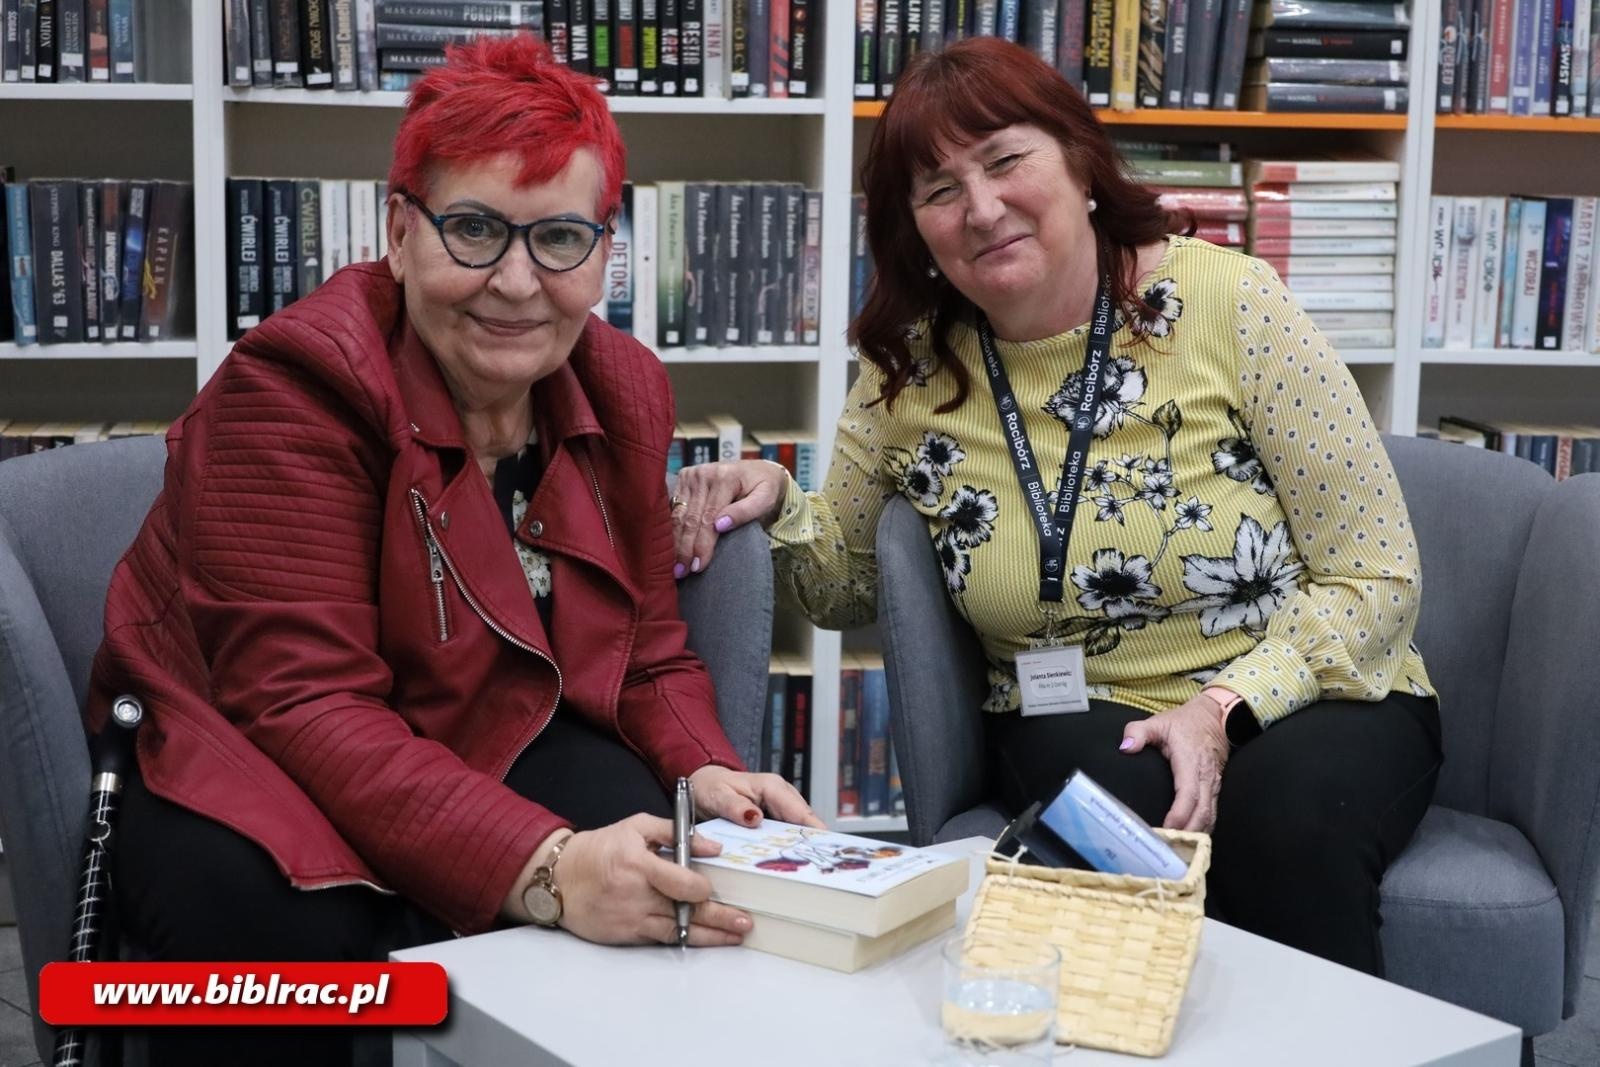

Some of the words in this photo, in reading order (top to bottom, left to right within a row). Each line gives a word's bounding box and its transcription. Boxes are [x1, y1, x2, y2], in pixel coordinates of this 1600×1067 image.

[40, 16, 52, 48] IMION
[885, 1, 899, 34] LINK
[907, 0, 921, 33] LINK
[929, 1, 942, 33] LINK
[390, 54, 412, 63] MAX
[571, 24, 588, 61] WINA
[661, 28, 679, 66] KREW
[682, 22, 702, 65] BESTIA
[706, 24, 721, 59] INNA
[240, 214, 259, 262] ĆWIRLEJ
[274, 215, 293, 263] ĆWIRLEJ
[51, 250, 65, 287] DALLAS
[610, 241, 628, 300] DETOKS
[1079, 349, 1103, 413] Racibórz
[1005, 411, 1031, 470] Racibórz
[1058, 449, 1082, 514] Biblioteka
[1027, 480, 1053, 538] Biblioteka
